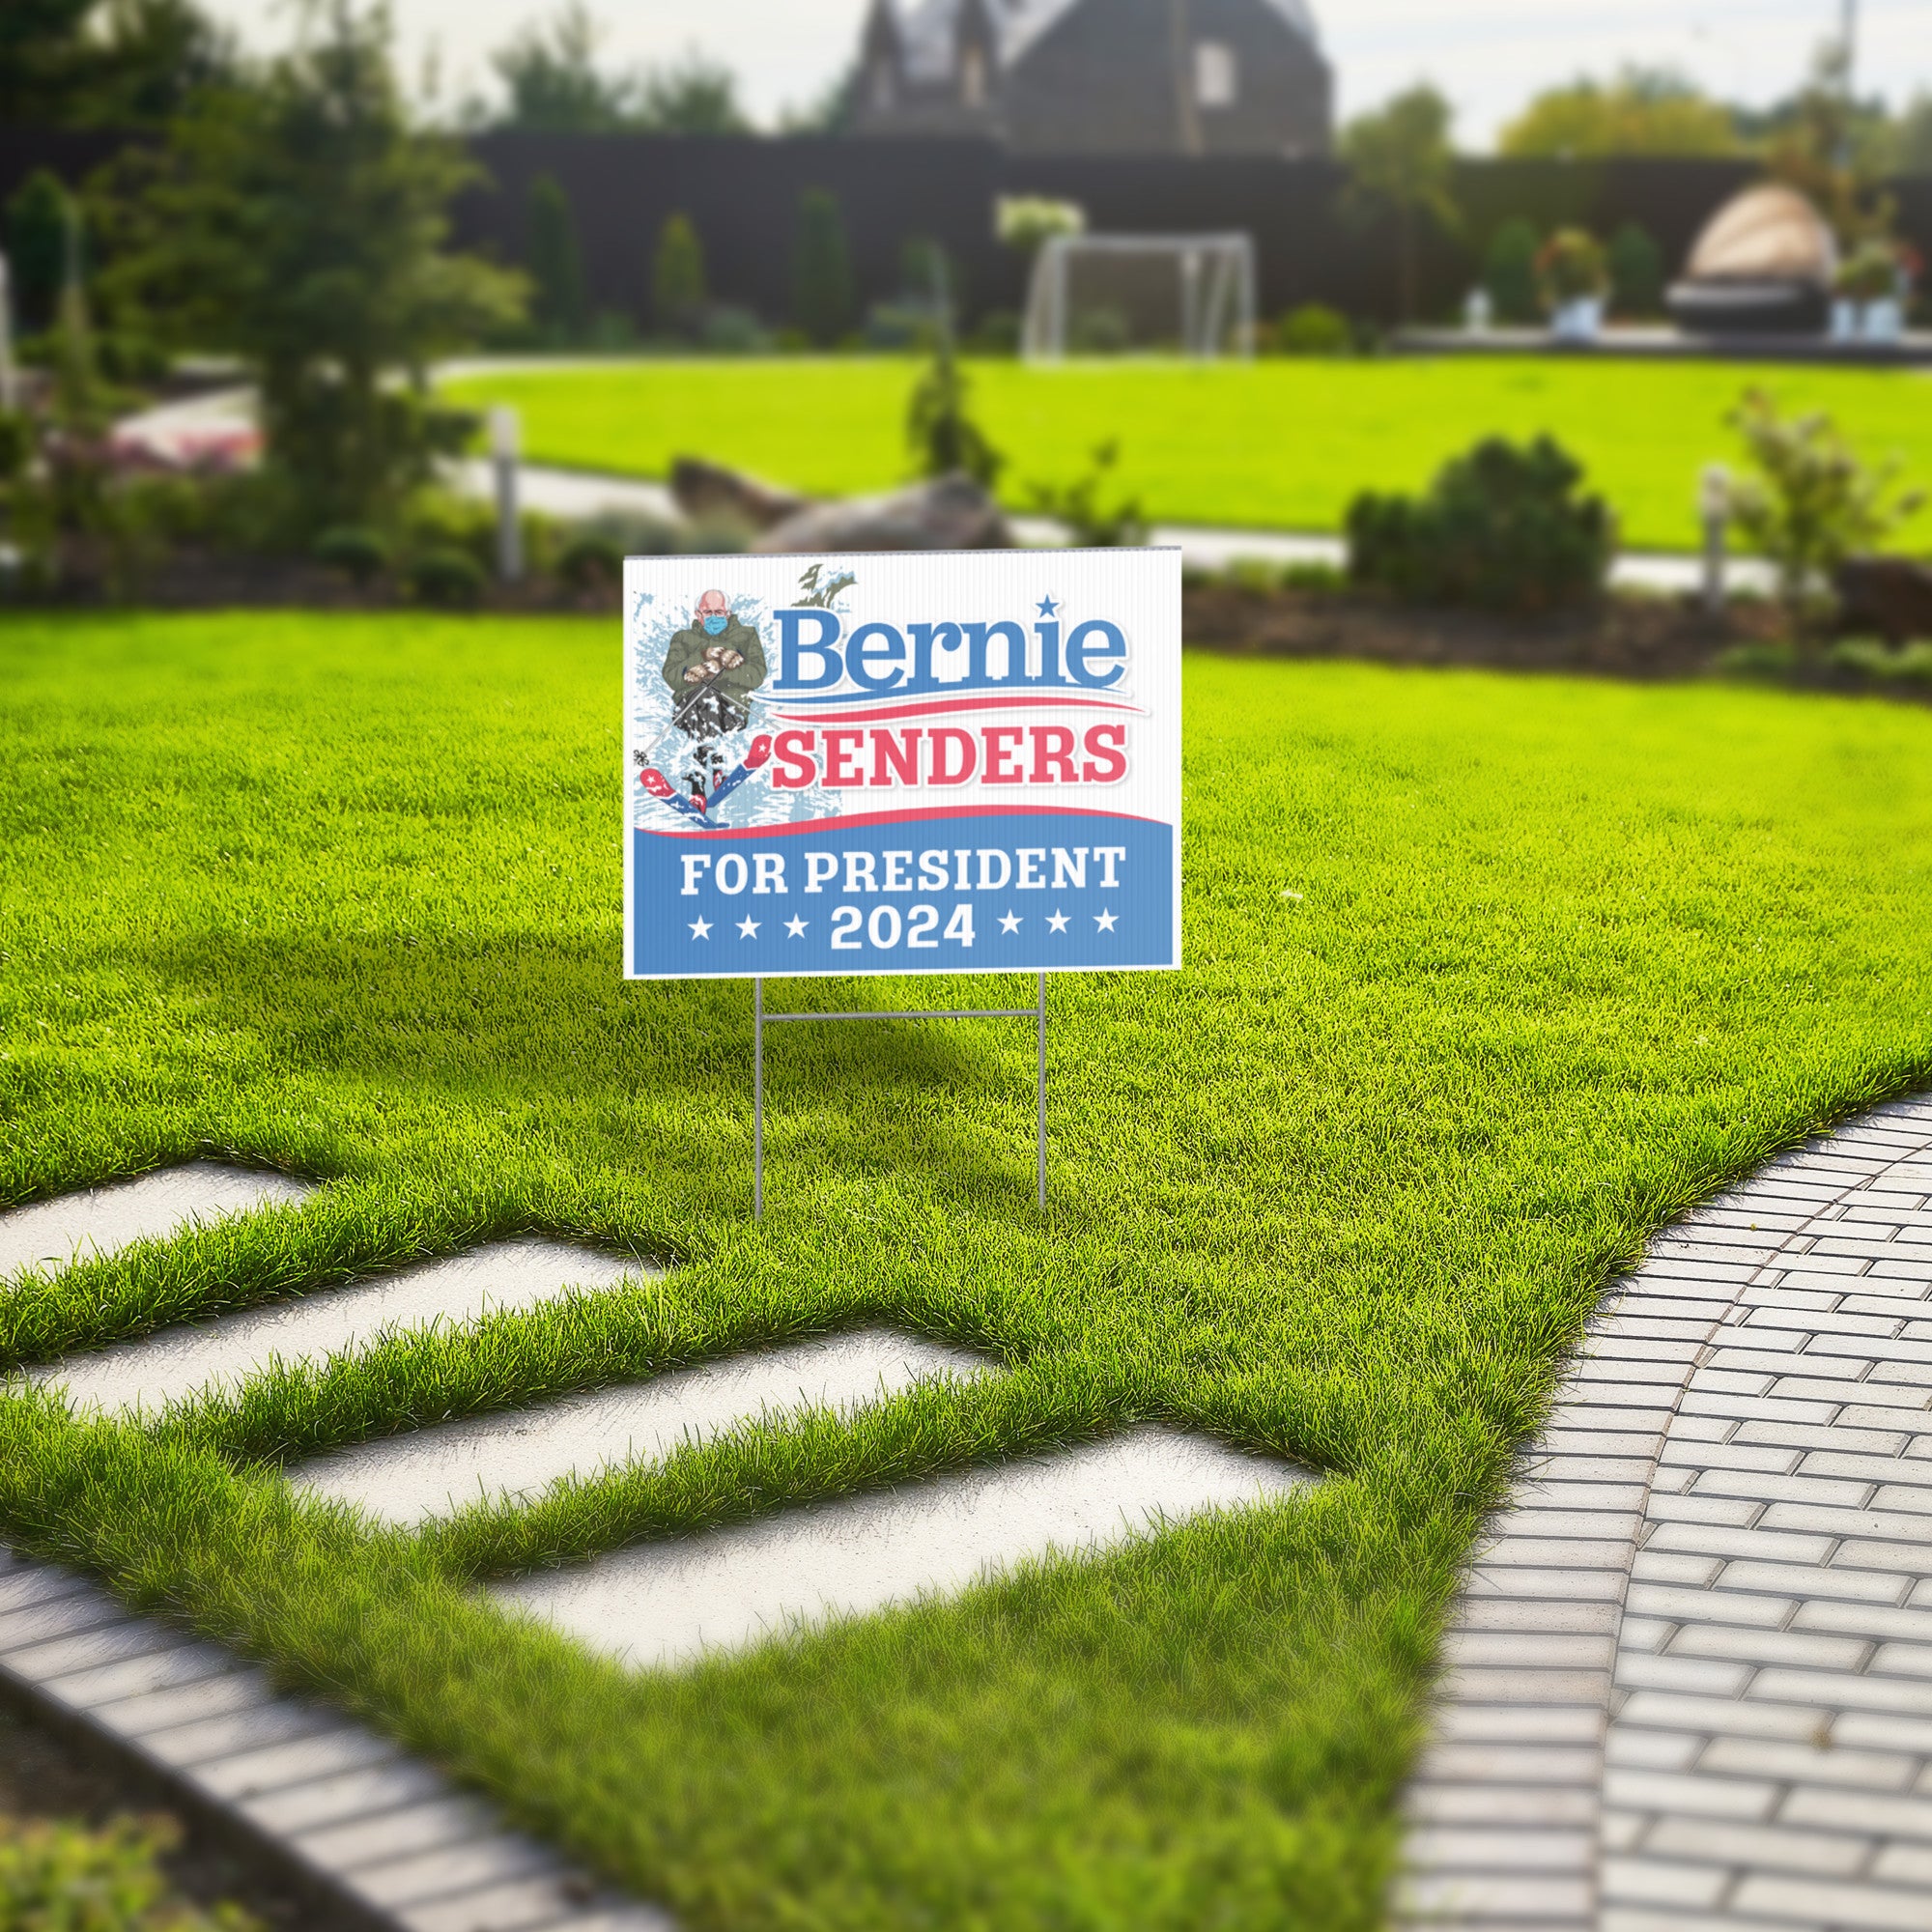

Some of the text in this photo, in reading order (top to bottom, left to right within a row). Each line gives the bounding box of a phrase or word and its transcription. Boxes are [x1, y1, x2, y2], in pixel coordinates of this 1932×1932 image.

[773, 595, 1126, 692] Bernie
[772, 724, 1127, 788] SENDERS
[680, 846, 1126, 895] FOR PRESIDENT
[831, 904, 976, 950] 2024
